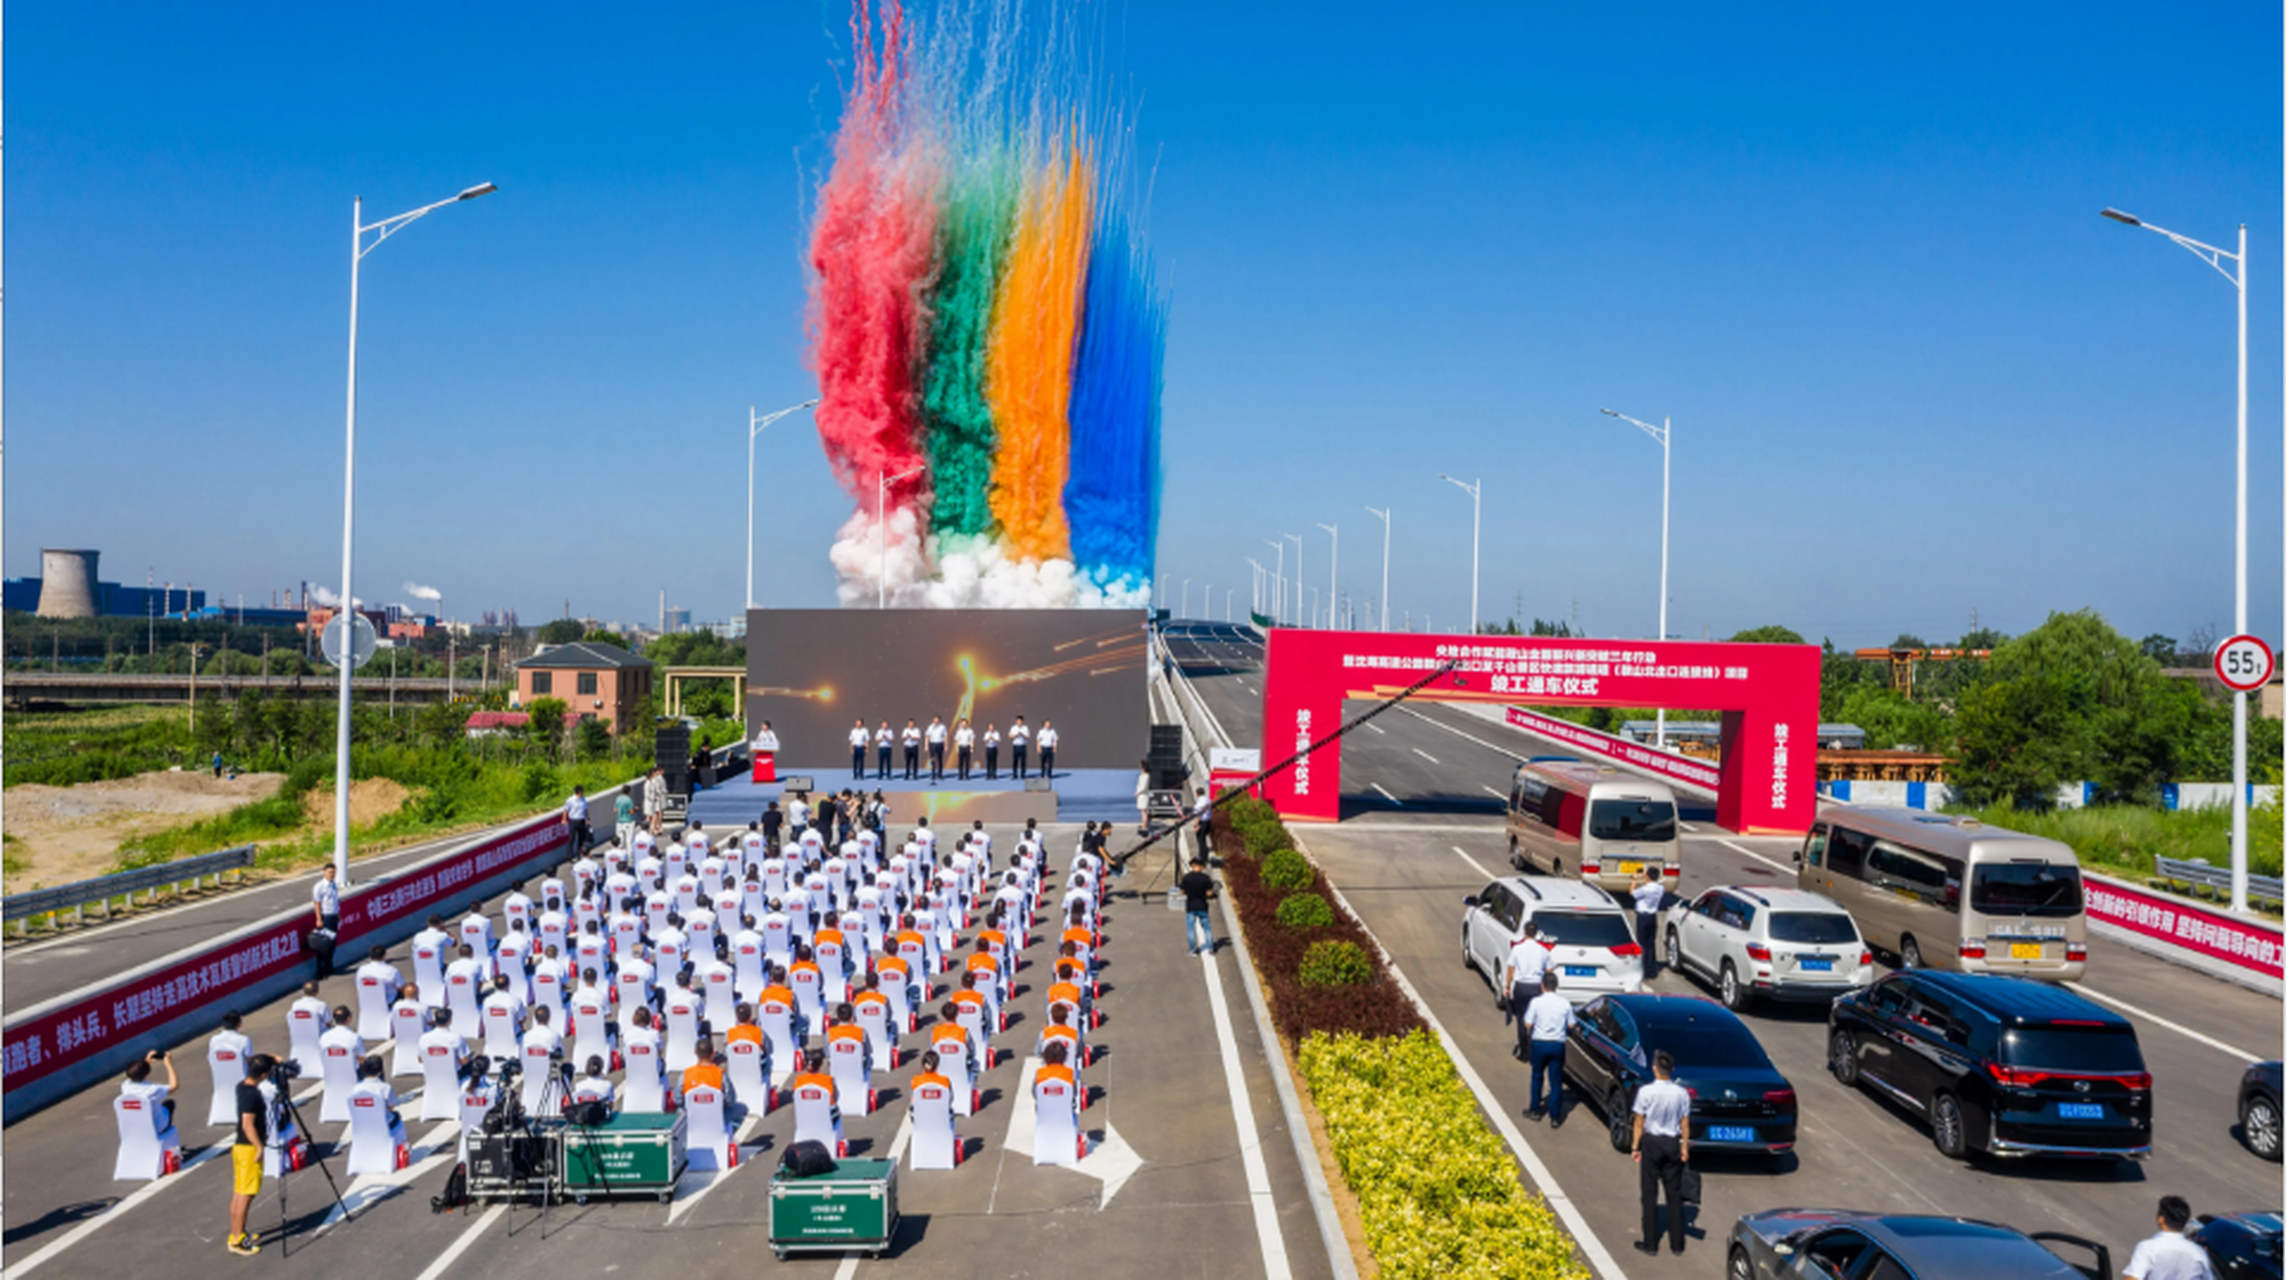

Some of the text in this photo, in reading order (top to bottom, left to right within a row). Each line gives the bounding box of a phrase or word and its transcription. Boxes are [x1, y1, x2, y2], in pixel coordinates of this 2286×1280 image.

[1490, 675, 1599, 696] 竣工通车仪式
[1771, 723, 1789, 809] 竣工通车仪式
